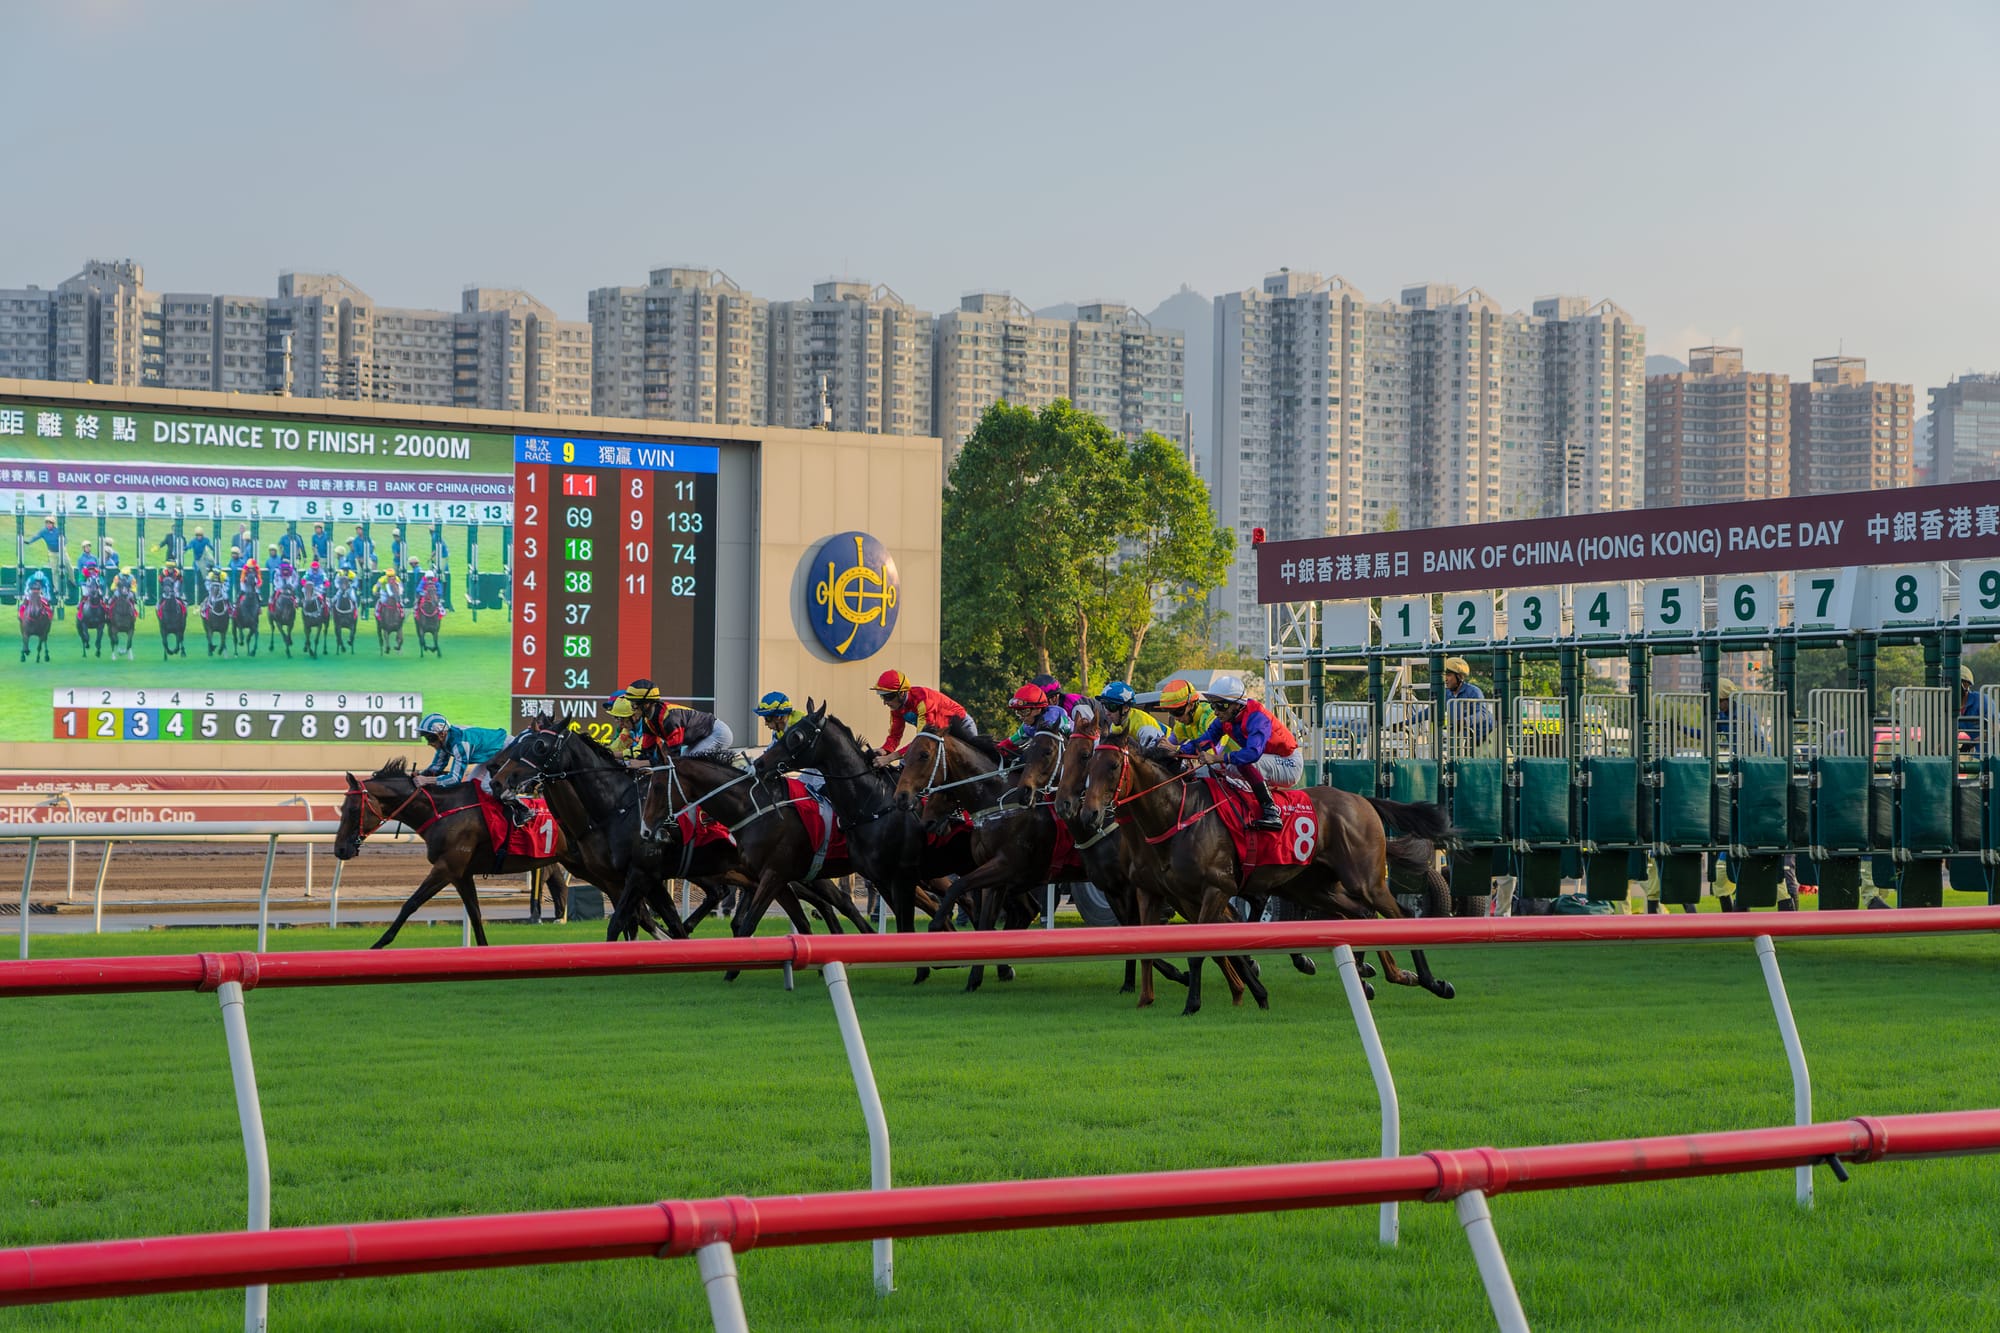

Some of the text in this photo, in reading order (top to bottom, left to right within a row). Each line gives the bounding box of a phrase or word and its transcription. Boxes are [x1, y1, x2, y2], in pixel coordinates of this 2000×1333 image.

[154, 420, 263, 448] DISTANCE
[271, 428, 299, 450] TO
[308, 430, 374, 455] FINISH
[394, 434, 470, 460] 2000M
[525, 451, 552, 462] RACE
[563, 442, 575, 463] 9
[599, 446, 674, 468] 獨贏 WIN
[58, 472, 91, 484] BANK
[94, 474, 111, 484] OF
[114, 474, 150, 486] CHINA
[152, 475, 189, 487] (HONG
[192, 476, 229, 489] KONG)
[232, 477, 262, 488] RACE
[266, 479, 288, 490] DAY
[385, 481, 415, 492] BANK
[418, 482, 434, 493] OF
[436, 483, 470, 494] CHINA
[471, 484, 506, 496] (HONG
[526, 472, 536, 493] 1
[566, 474, 593, 496] 1.1
[630, 478, 644, 498] 8
[675, 480, 694, 501] 11
[37, 494, 45, 508] 1
[76, 496, 88, 510] 2
[117, 496, 127, 510] 3
[155, 498, 166, 511] 4
[194, 498, 204, 512] 5
[231, 500, 242, 513] 6
[269, 500, 280, 514] 7
[307, 502, 317, 514] 8
[343, 502, 354, 516] 9
[375, 503, 394, 516] 10
[412, 504, 430, 517] 11
[448, 504, 466, 518] 12
[484, 506, 502, 519] 13
[524, 505, 538, 526] 2
[566, 507, 592, 528] 69
[630, 510, 643, 530] 9
[667, 512, 703, 533] 133
[524, 537, 538, 558] 3
[568, 539, 592, 560] 18
[625, 542, 650, 562] 10
[672, 544, 696, 564] 74
[1280, 520, 1844, 586] 中銀香港賽馬日 BANK OF CHINA (HONG KONG) RACE DAY
[523, 570, 537, 590] 4
[566, 572, 592, 593] 38
[626, 574, 646, 594] 11
[671, 576, 696, 596] 82
[1978, 570, 2000, 610] 9
[1734, 584, 1756, 622] 6
[1811, 578, 1835, 618] 7
[1894, 574, 1918, 614] 8
[522, 602, 537, 623] 5
[564, 604, 591, 625] 37
[1523, 596, 1542, 630] 3
[1588, 592, 1610, 628] 4
[1660, 588, 1682, 625] 5
[1398, 603, 1410, 637] 1
[1457, 600, 1476, 635] 2
[522, 634, 536, 656] 6
[564, 636, 590, 657] 58
[522, 668, 536, 688] 7
[564, 669, 590, 690] 34
[67, 690, 74, 704] 1
[102, 690, 111, 705] 2
[136, 691, 146, 706] 3
[170, 692, 180, 706] 4
[205, 692, 214, 706] 5
[239, 692, 248, 707] 6
[272, 693, 280, 707] 7
[305, 694, 314, 708] 8
[338, 694, 346, 708] 9
[366, 695, 384, 709] 10
[399, 696, 414, 710] 11
[560, 700, 597, 718] WIN
[62, 712, 76, 736] 1
[97, 712, 114, 736] 2
[132, 712, 150, 737] 3
[166, 712, 184, 738] 4
[200, 713, 218, 738] 5
[234, 714, 252, 738] 6
[268, 714, 285, 738] 7
[301, 714, 318, 738] 8
[333, 715, 350, 738] 9
[360, 715, 388, 739] 10
[394, 716, 420, 739] 11
[588, 722, 613, 744] 22
[42, 808, 107, 823] Jockey
[112, 808, 154, 823] Club
[159, 808, 196, 822] Cup
[540, 819, 553, 854] 1
[1294, 816, 1315, 862] 8
